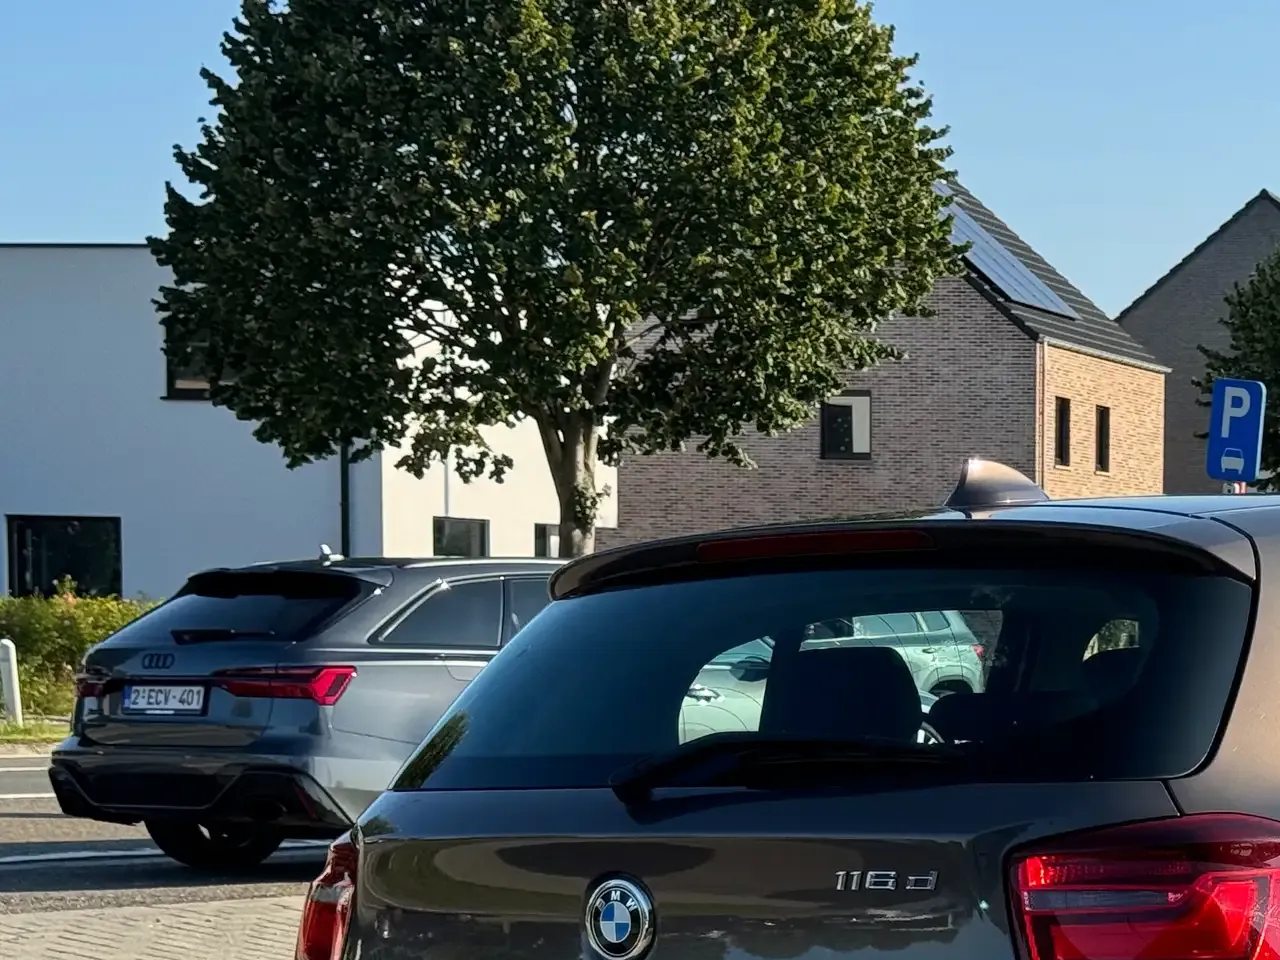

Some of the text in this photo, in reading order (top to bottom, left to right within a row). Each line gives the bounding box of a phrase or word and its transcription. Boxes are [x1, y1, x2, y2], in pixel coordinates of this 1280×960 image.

[1221, 386, 1251, 438] P
[835, 871, 897, 890] 116
[596, 890, 638, 912] BMW
